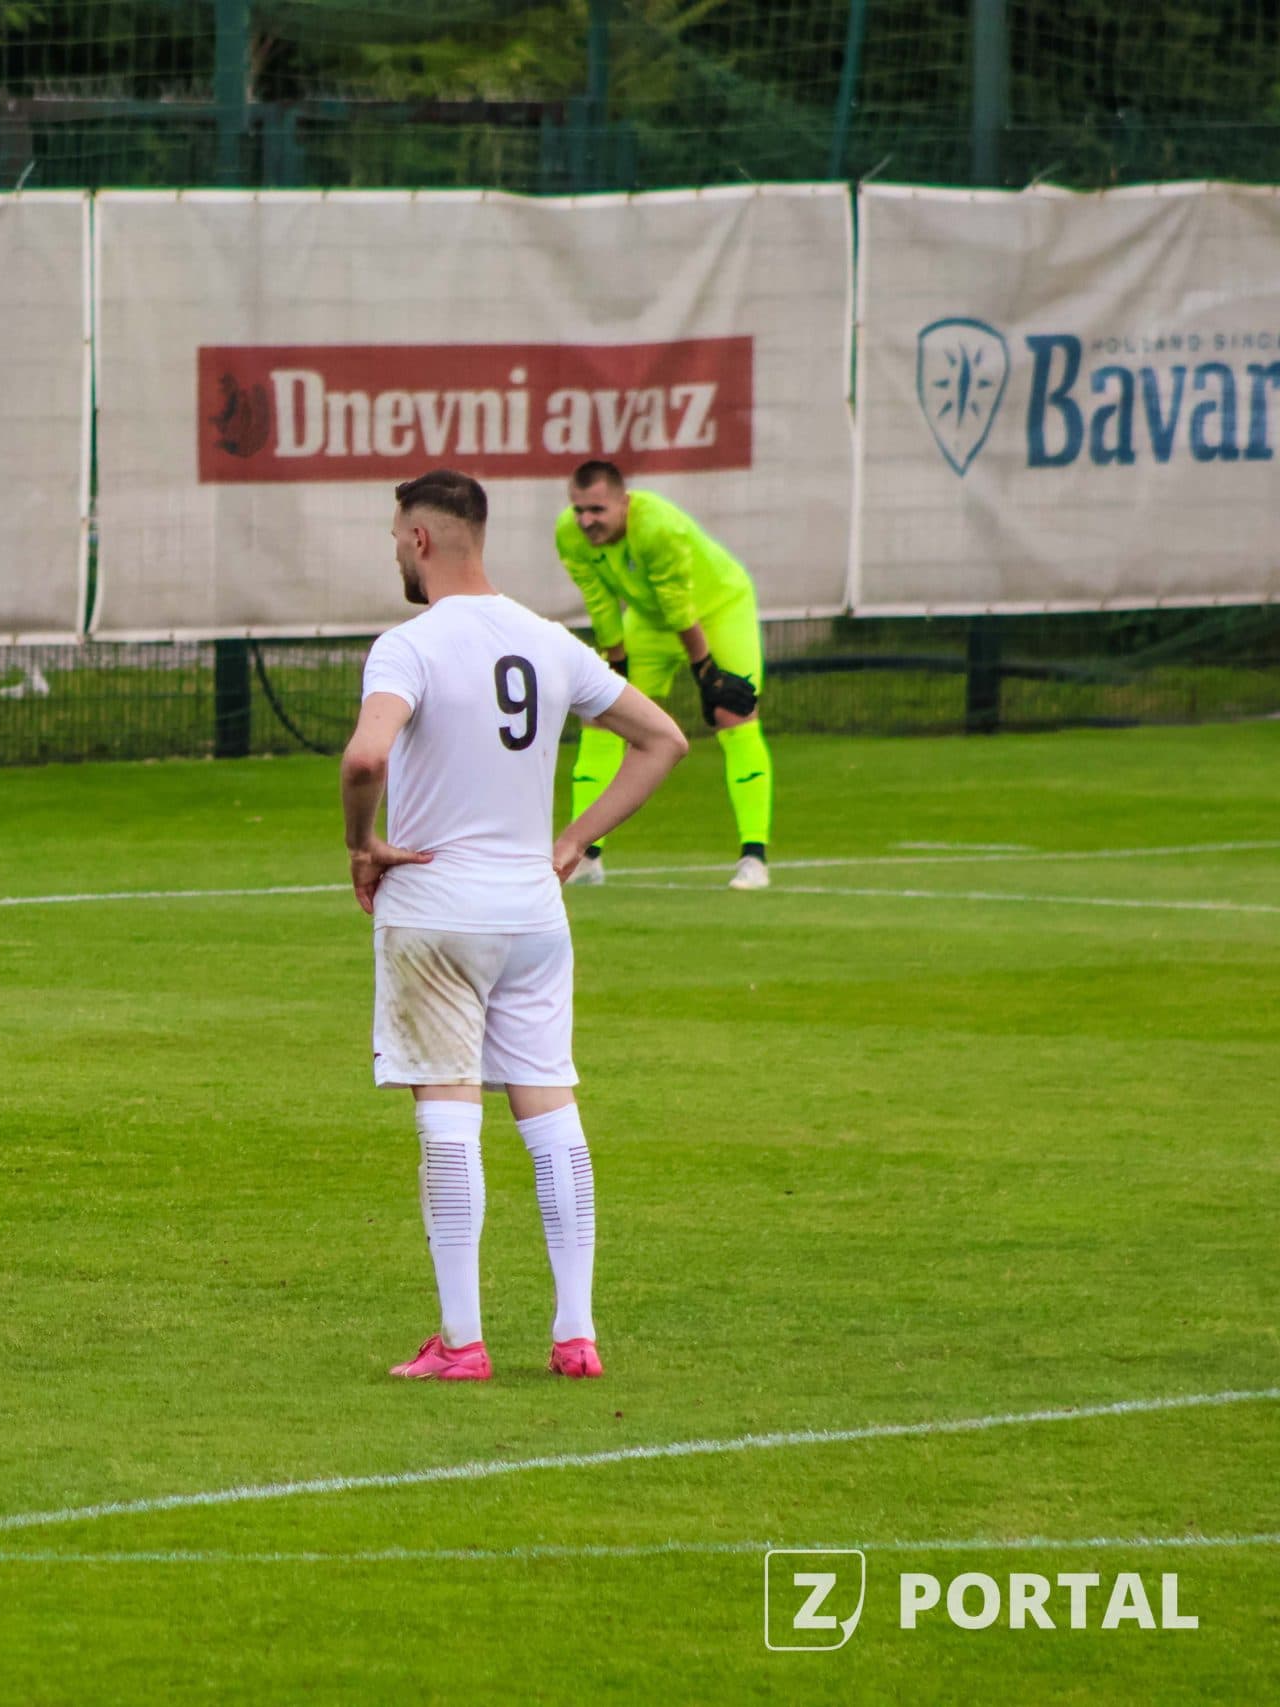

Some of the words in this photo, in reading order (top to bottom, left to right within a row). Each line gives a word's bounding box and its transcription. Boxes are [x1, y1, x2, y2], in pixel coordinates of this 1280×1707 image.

[1213, 331, 1280, 351] SINC
[269, 367, 530, 458] Dnevni
[542, 382, 718, 455] avaz
[494, 655, 538, 751] 9
